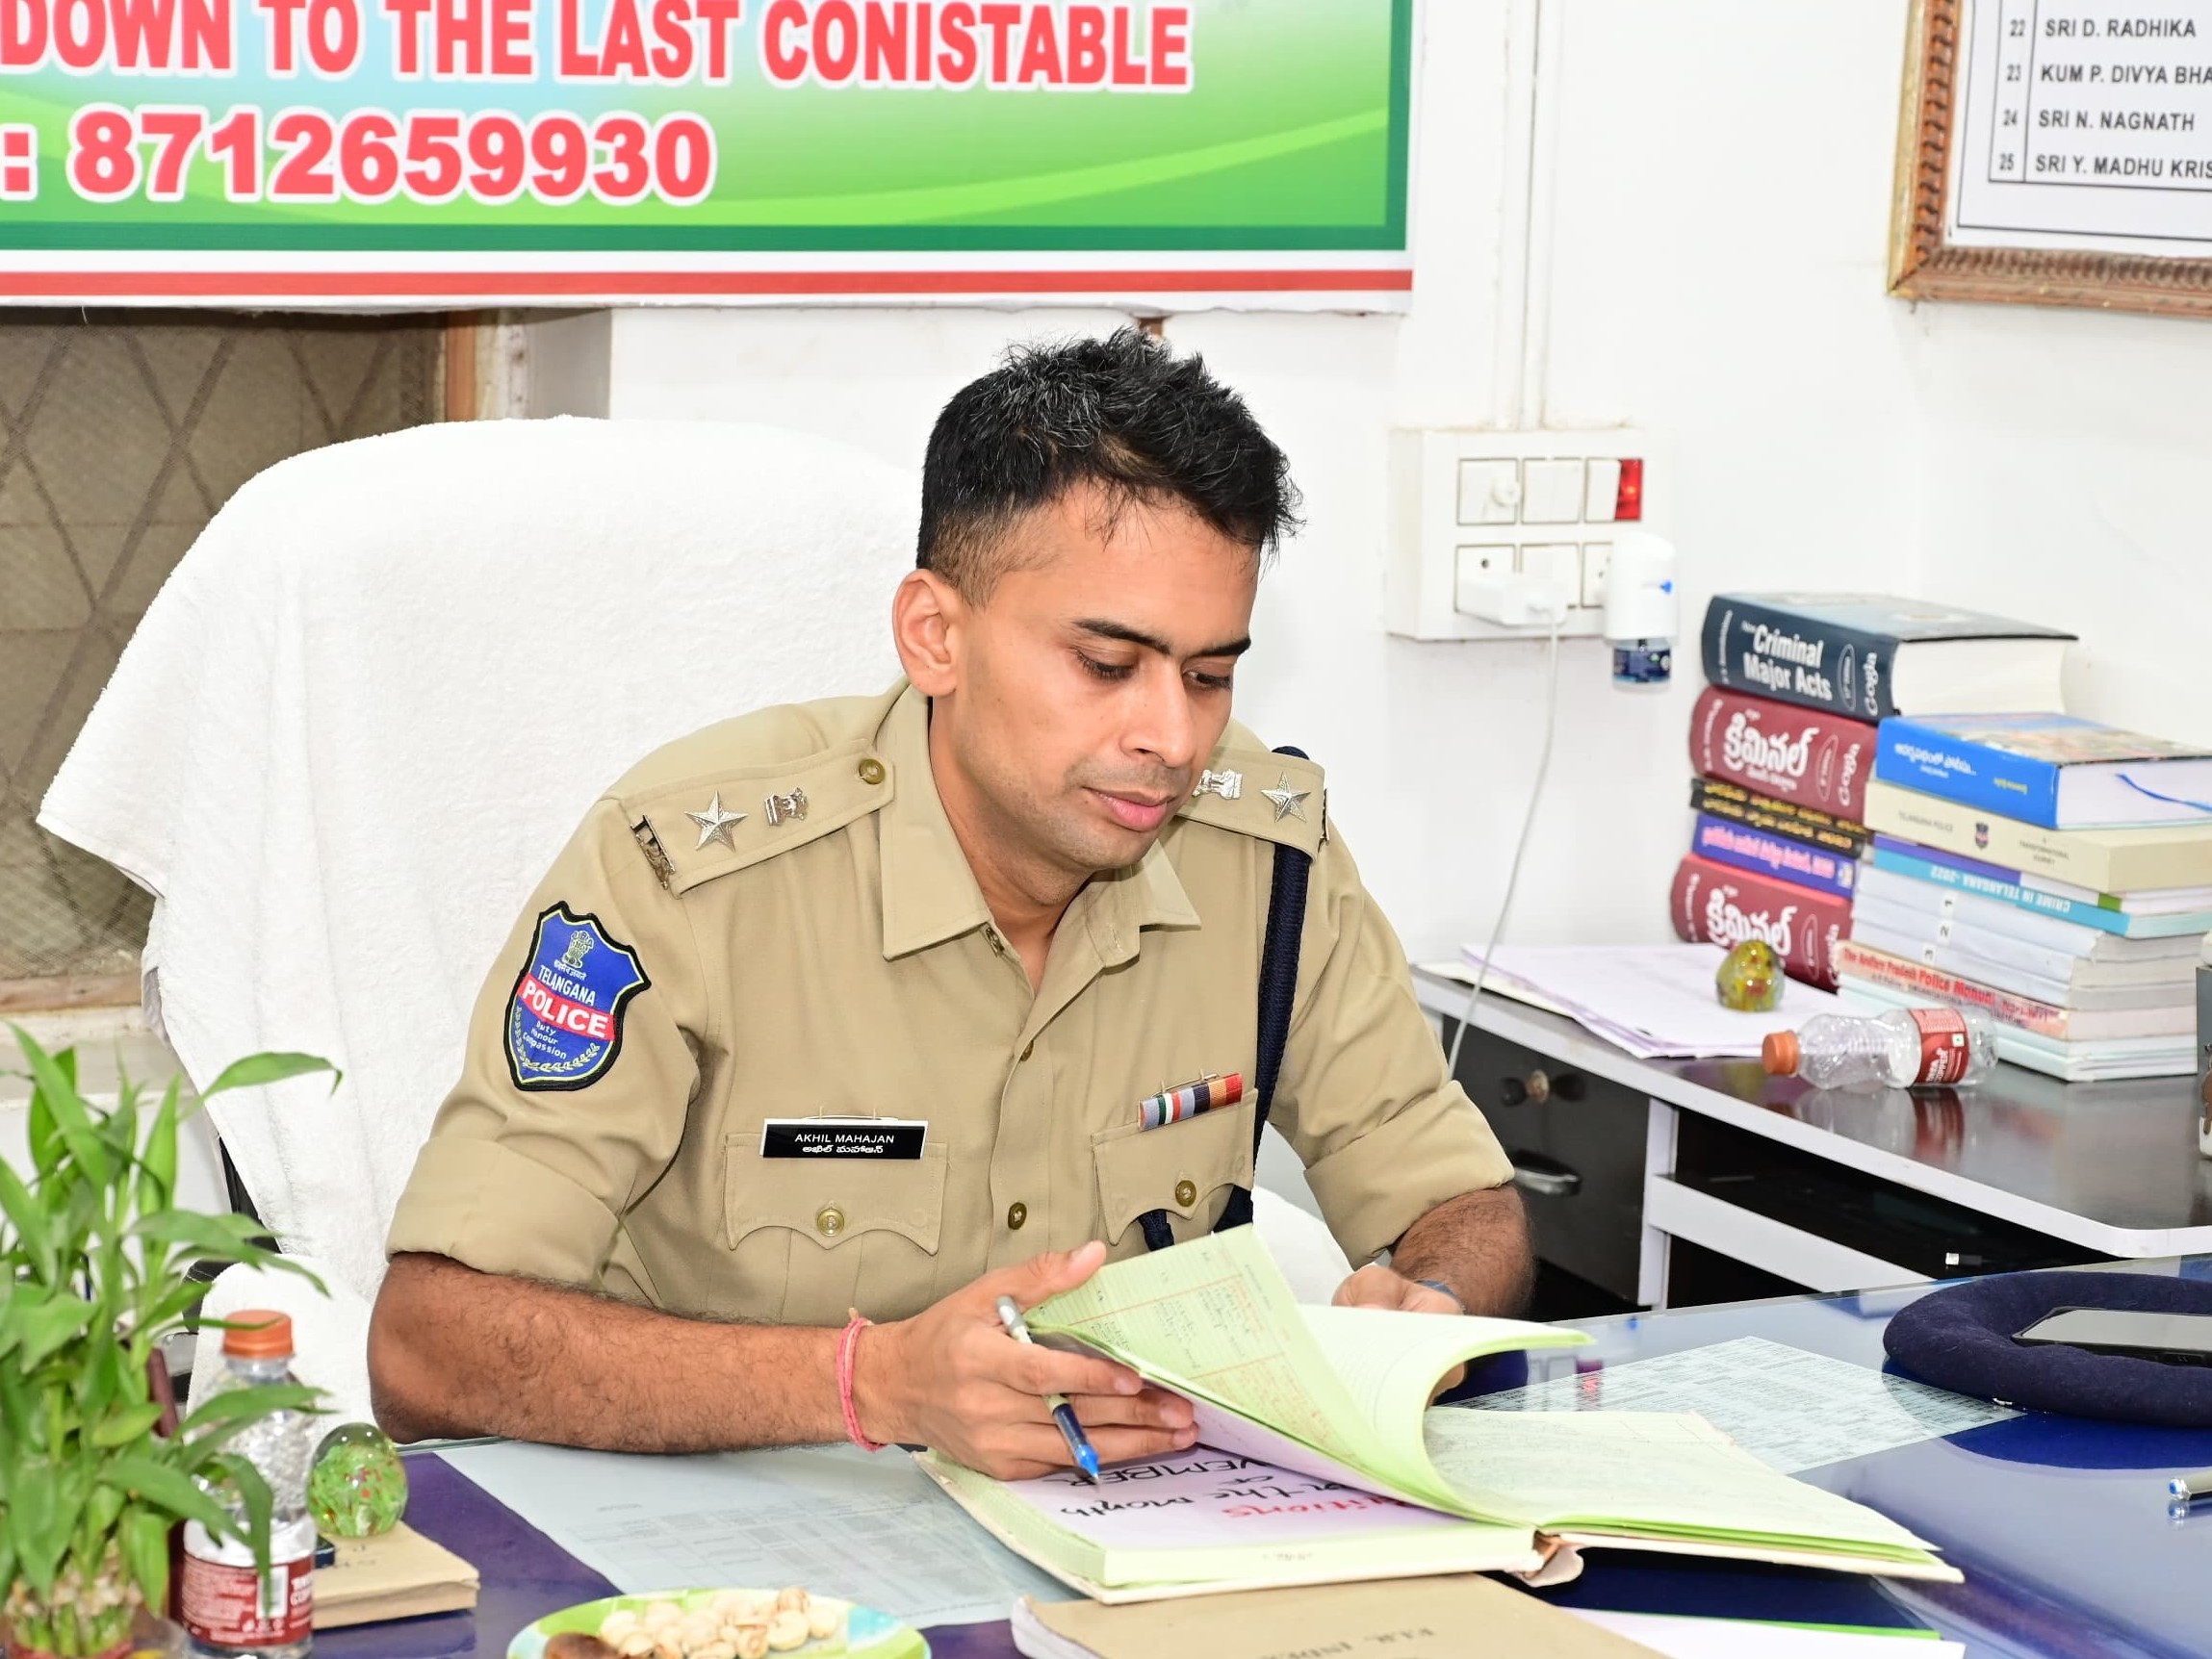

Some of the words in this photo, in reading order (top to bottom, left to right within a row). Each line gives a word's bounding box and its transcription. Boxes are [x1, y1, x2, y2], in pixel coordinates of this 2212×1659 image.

[0, 0, 231, 69] DOWN
[260, 0, 358, 73] TO
[386, 0, 532, 76] THE
[560, 0, 739, 79] LAST
[764, 0, 1188, 86] CONISTABLE
[2045, 19, 2076, 37] SRI
[2083, 19, 2100, 37] D.
[2107, 19, 2197, 38] RADHIKA
[2041, 64, 2083, 82] KUM
[2090, 65, 2104, 83] P.
[2111, 65, 2168, 84] DIVYA
[2003, 110, 2018, 126] 24
[2039, 110, 2070, 128] SRI
[2075, 111, 2094, 128] N.
[2100, 112, 2195, 131] NAGNATH
[73, 111, 711, 198] 8712659930
[1999, 153, 2015, 171] 25
[2035, 154, 2066, 173] SRI
[2072, 156, 2087, 173] Y.
[2094, 157, 2164, 177] MADHU
[1752, 624, 1825, 668] Criminal
[1743, 652, 1791, 691] Major
[1795, 666, 1833, 701] Acts
[538, 964, 597, 1008] TELANGANA
[522, 980, 610, 1039] POLICE
[794, 1134, 832, 1143] AKHIL
[835, 1134, 896, 1144] MAHAJAN
